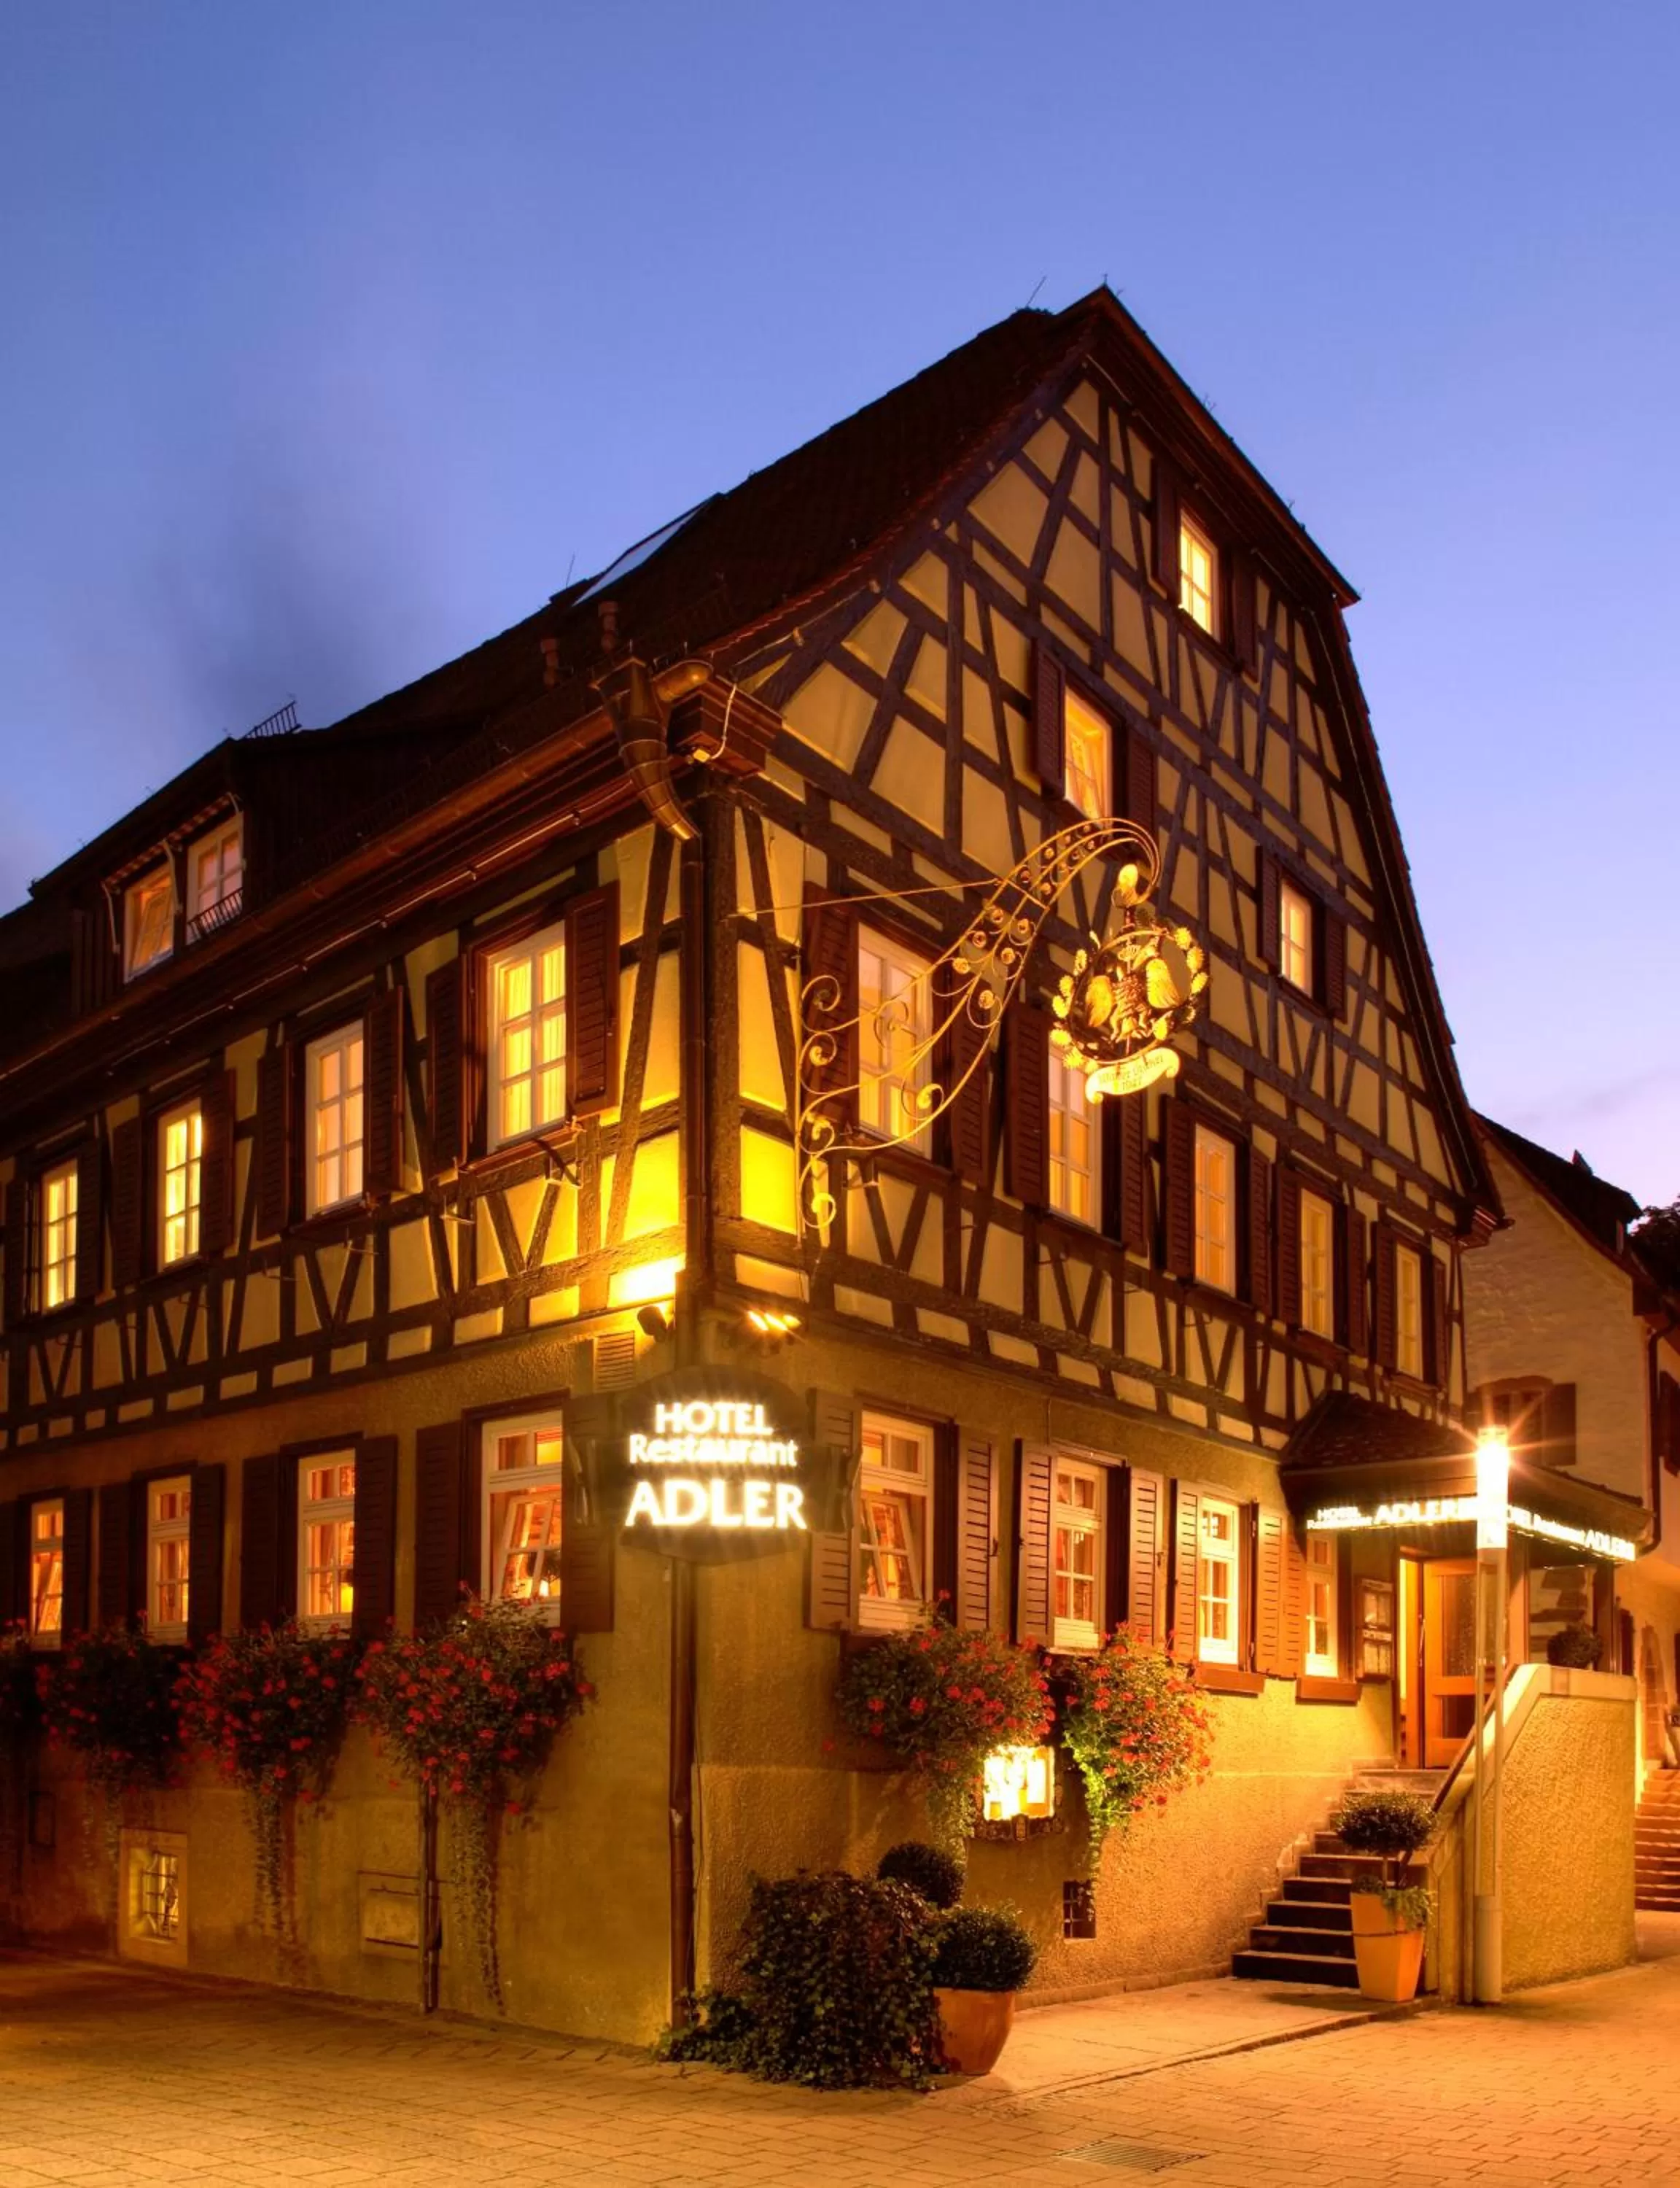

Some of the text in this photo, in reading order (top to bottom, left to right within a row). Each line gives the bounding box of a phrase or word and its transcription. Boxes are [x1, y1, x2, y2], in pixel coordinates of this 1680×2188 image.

[656, 1402, 774, 1435] HOTEL
[629, 1434, 798, 1466] Restaurant
[625, 1479, 806, 1529] ADLER
[1373, 1500, 1461, 1524] ADLER
